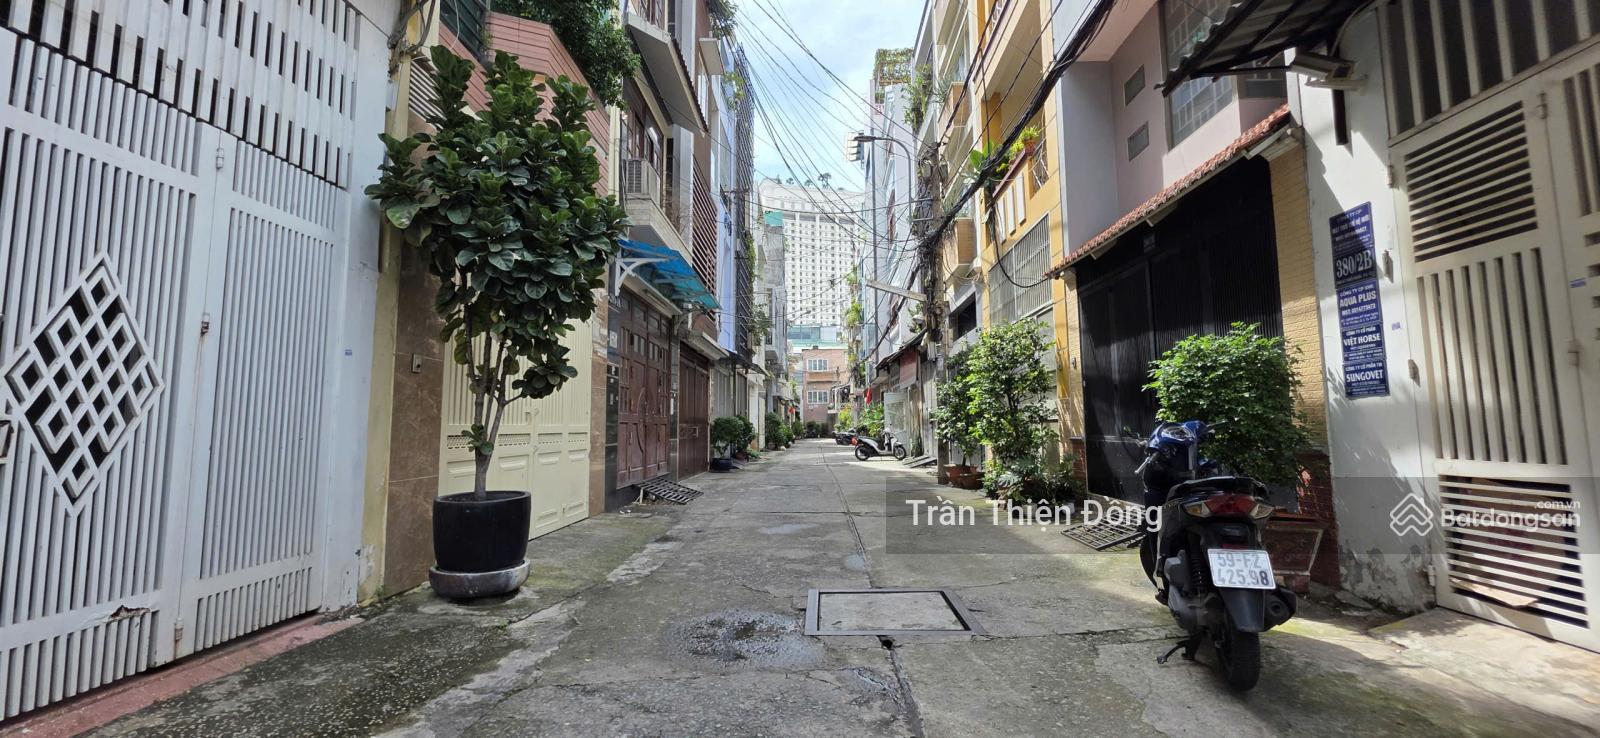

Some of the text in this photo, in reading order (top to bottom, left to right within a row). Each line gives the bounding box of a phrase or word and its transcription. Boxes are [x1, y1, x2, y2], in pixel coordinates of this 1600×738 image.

[1336, 250, 1373, 278] 380/2B
[1340, 290, 1376, 307] AQUA PLUS
[1343, 336, 1357, 347] VIỆT
[1358, 333, 1381, 344] HORSE
[1345, 369, 1383, 382] SUNGOVET
[1217, 552, 1262, 569] 59-F2
[1217, 568, 1270, 586] 425.98
